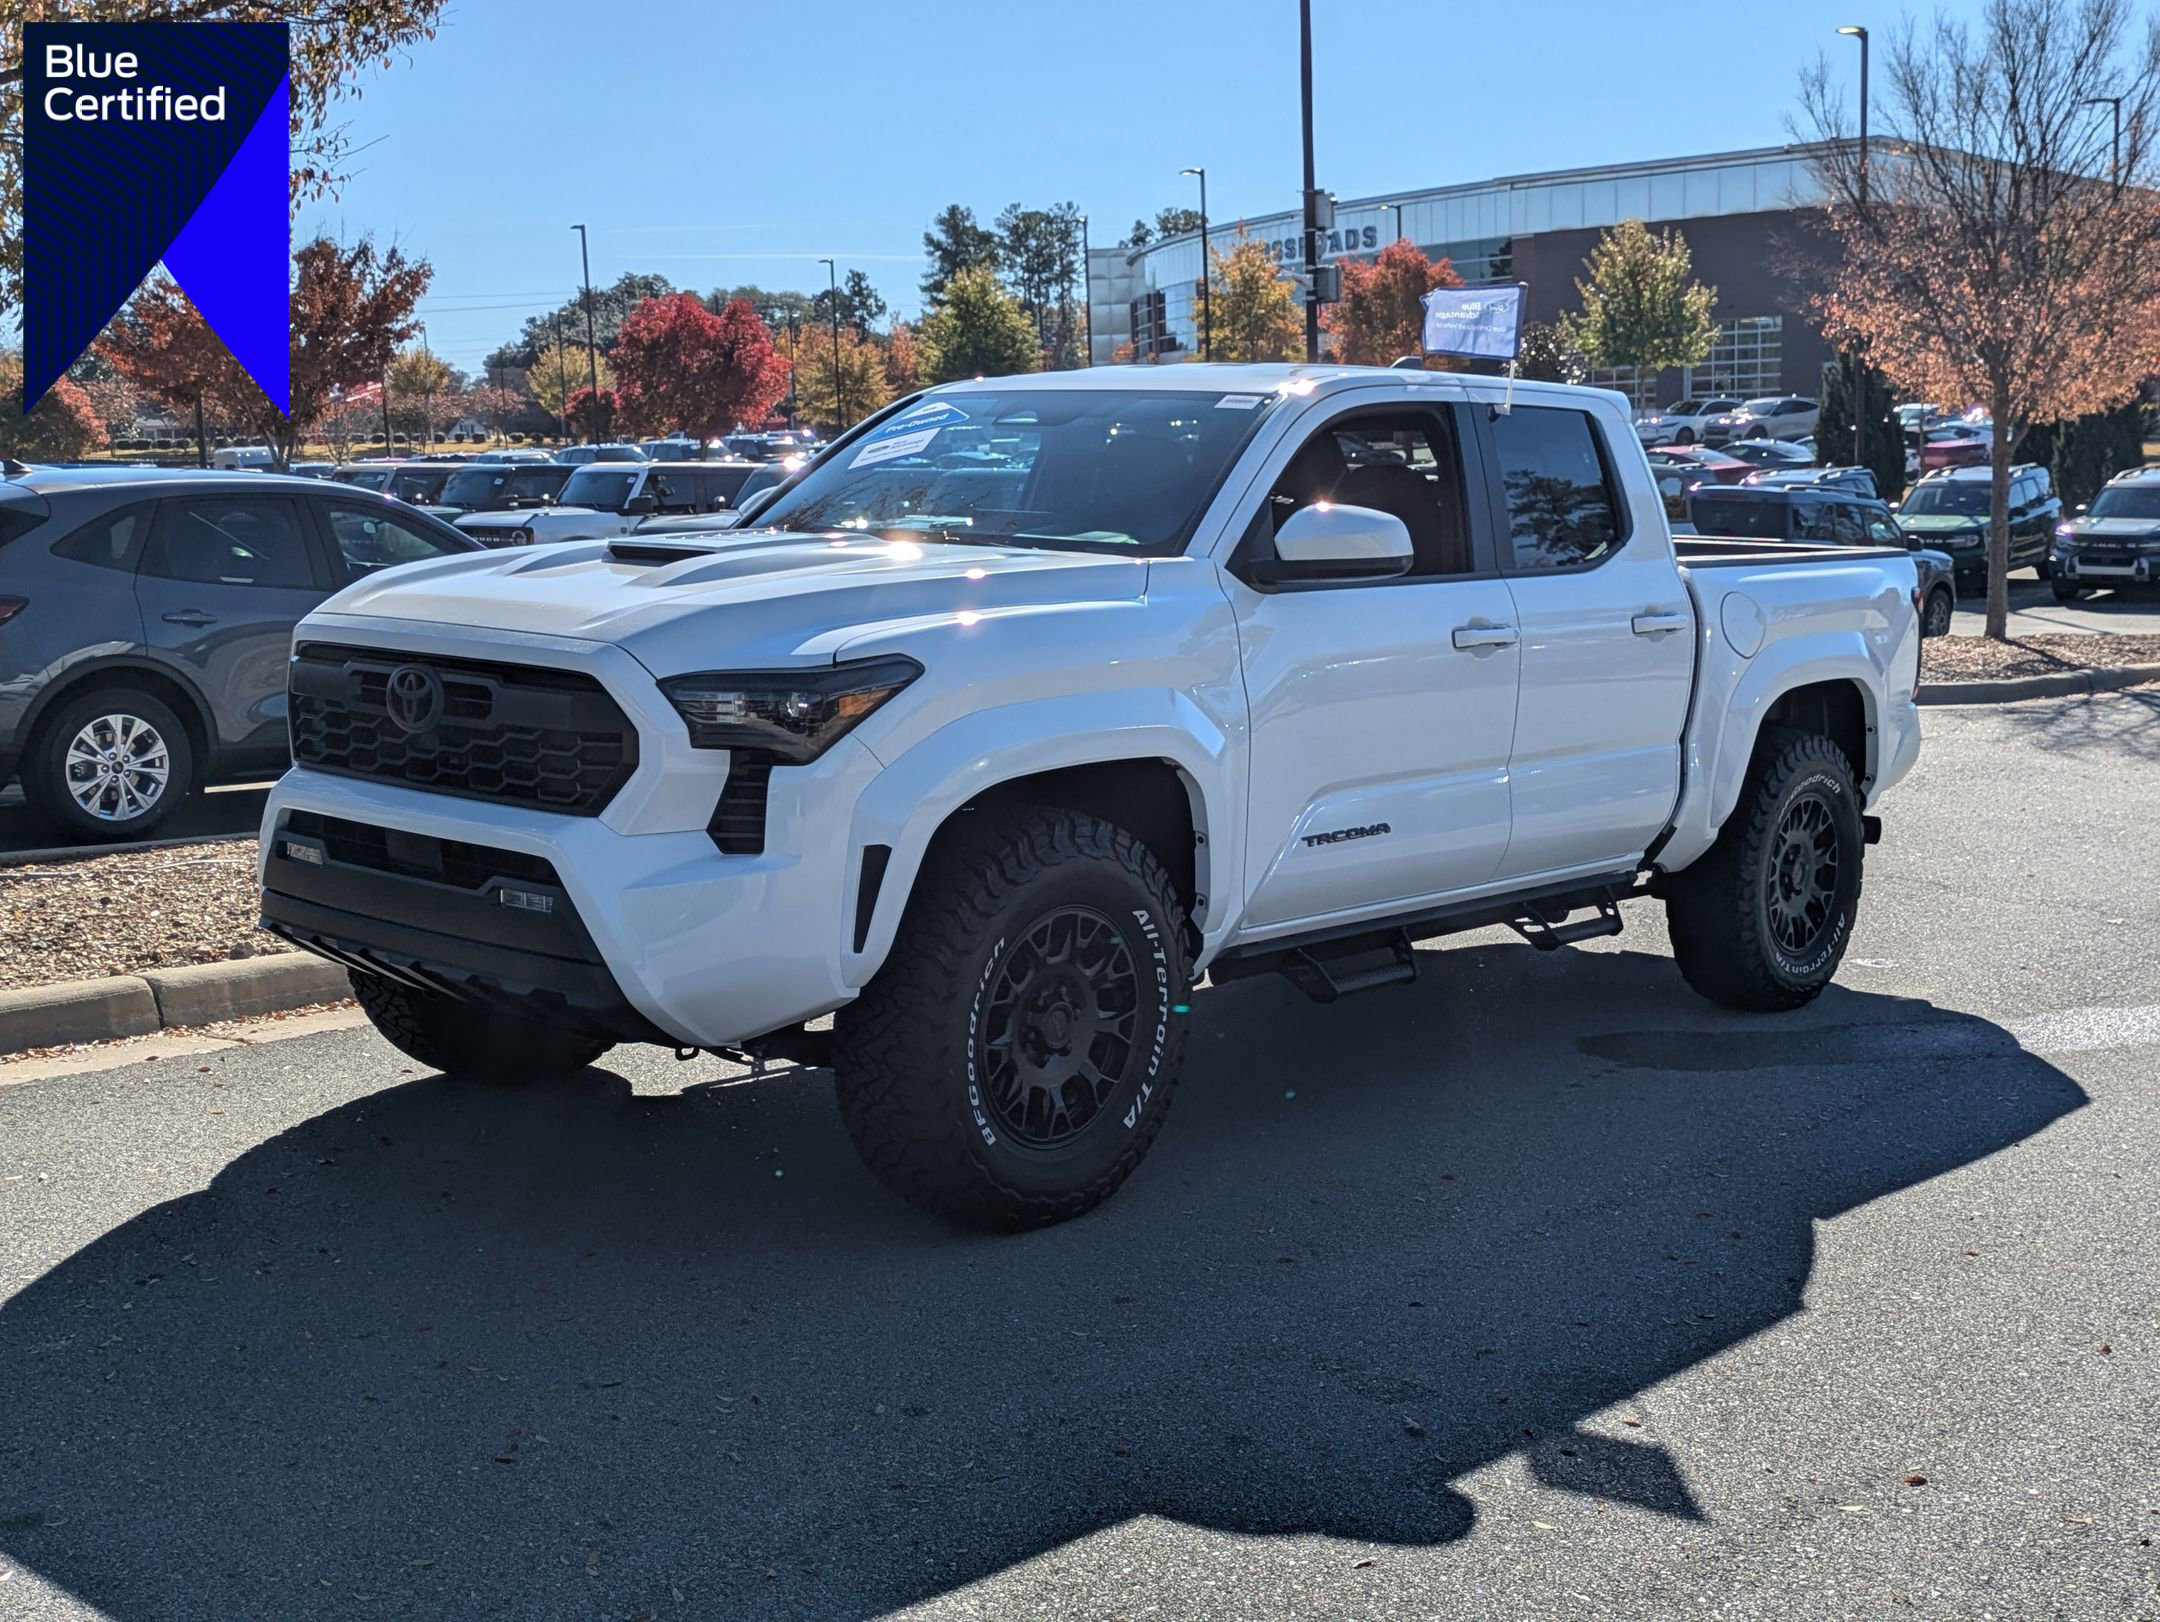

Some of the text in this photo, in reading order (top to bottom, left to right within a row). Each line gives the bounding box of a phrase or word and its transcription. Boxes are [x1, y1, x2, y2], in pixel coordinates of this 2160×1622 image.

[1301, 822, 1392, 847] TACOMA
[1791, 911, 1846, 976] All-Terrain
[967, 937, 1005, 1146] BFGoodrich
[1122, 909, 1169, 1129] All-Terrain T/A
